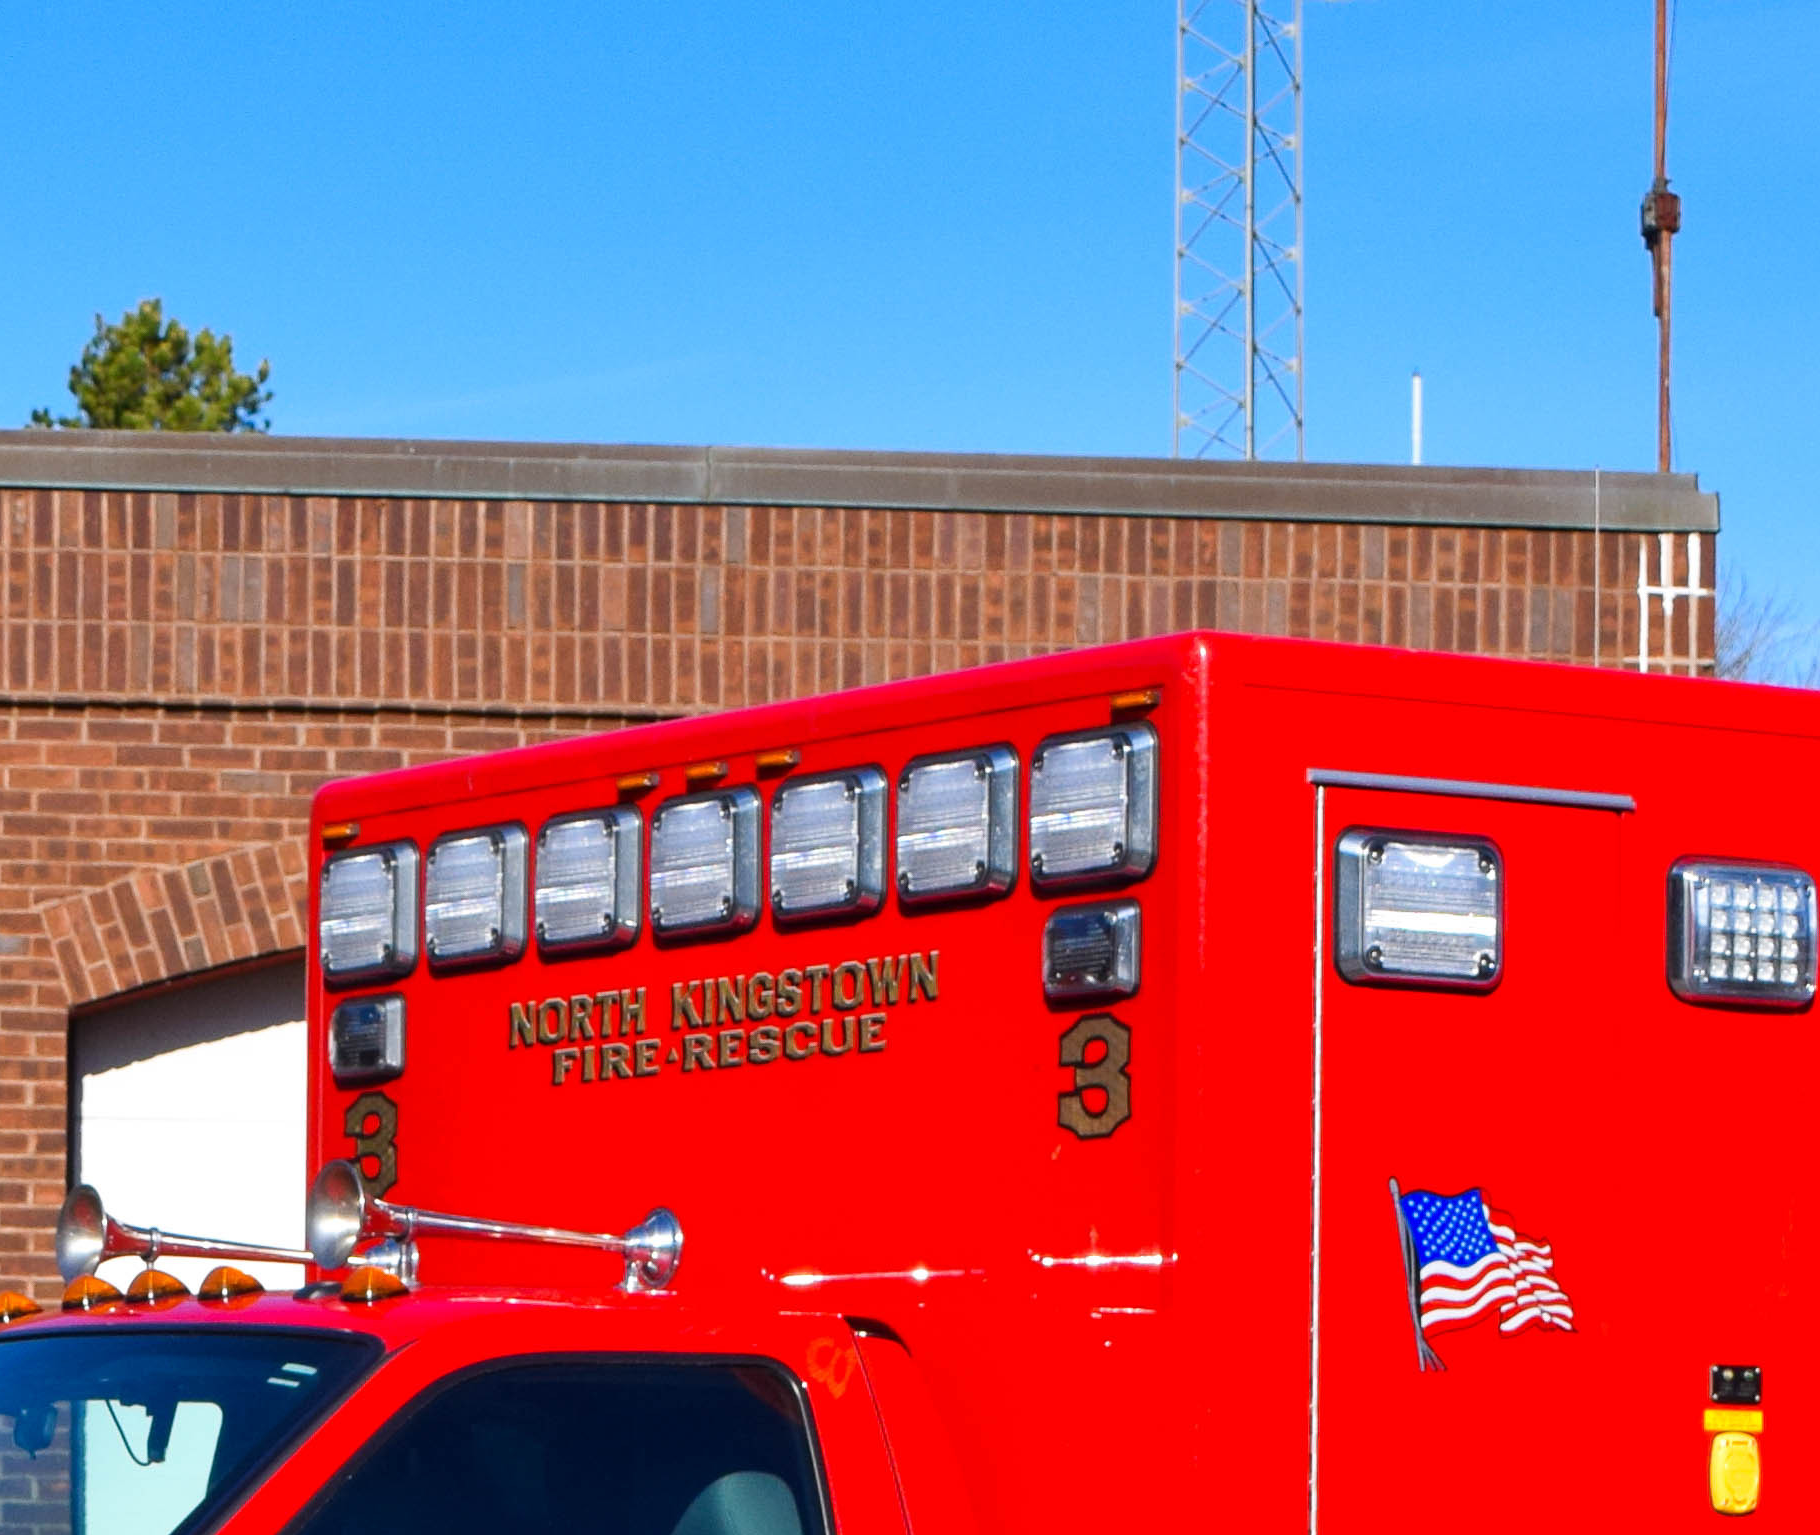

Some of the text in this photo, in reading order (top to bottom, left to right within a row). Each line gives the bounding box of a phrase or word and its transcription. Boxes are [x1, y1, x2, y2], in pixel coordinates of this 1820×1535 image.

[509, 950, 941, 1048] NORTH KINGSTOWN
[551, 1012, 887, 1086] FIRE RESCUE
[1057, 1012, 1133, 1140] 3
[344, 1089, 398, 1200] 3
